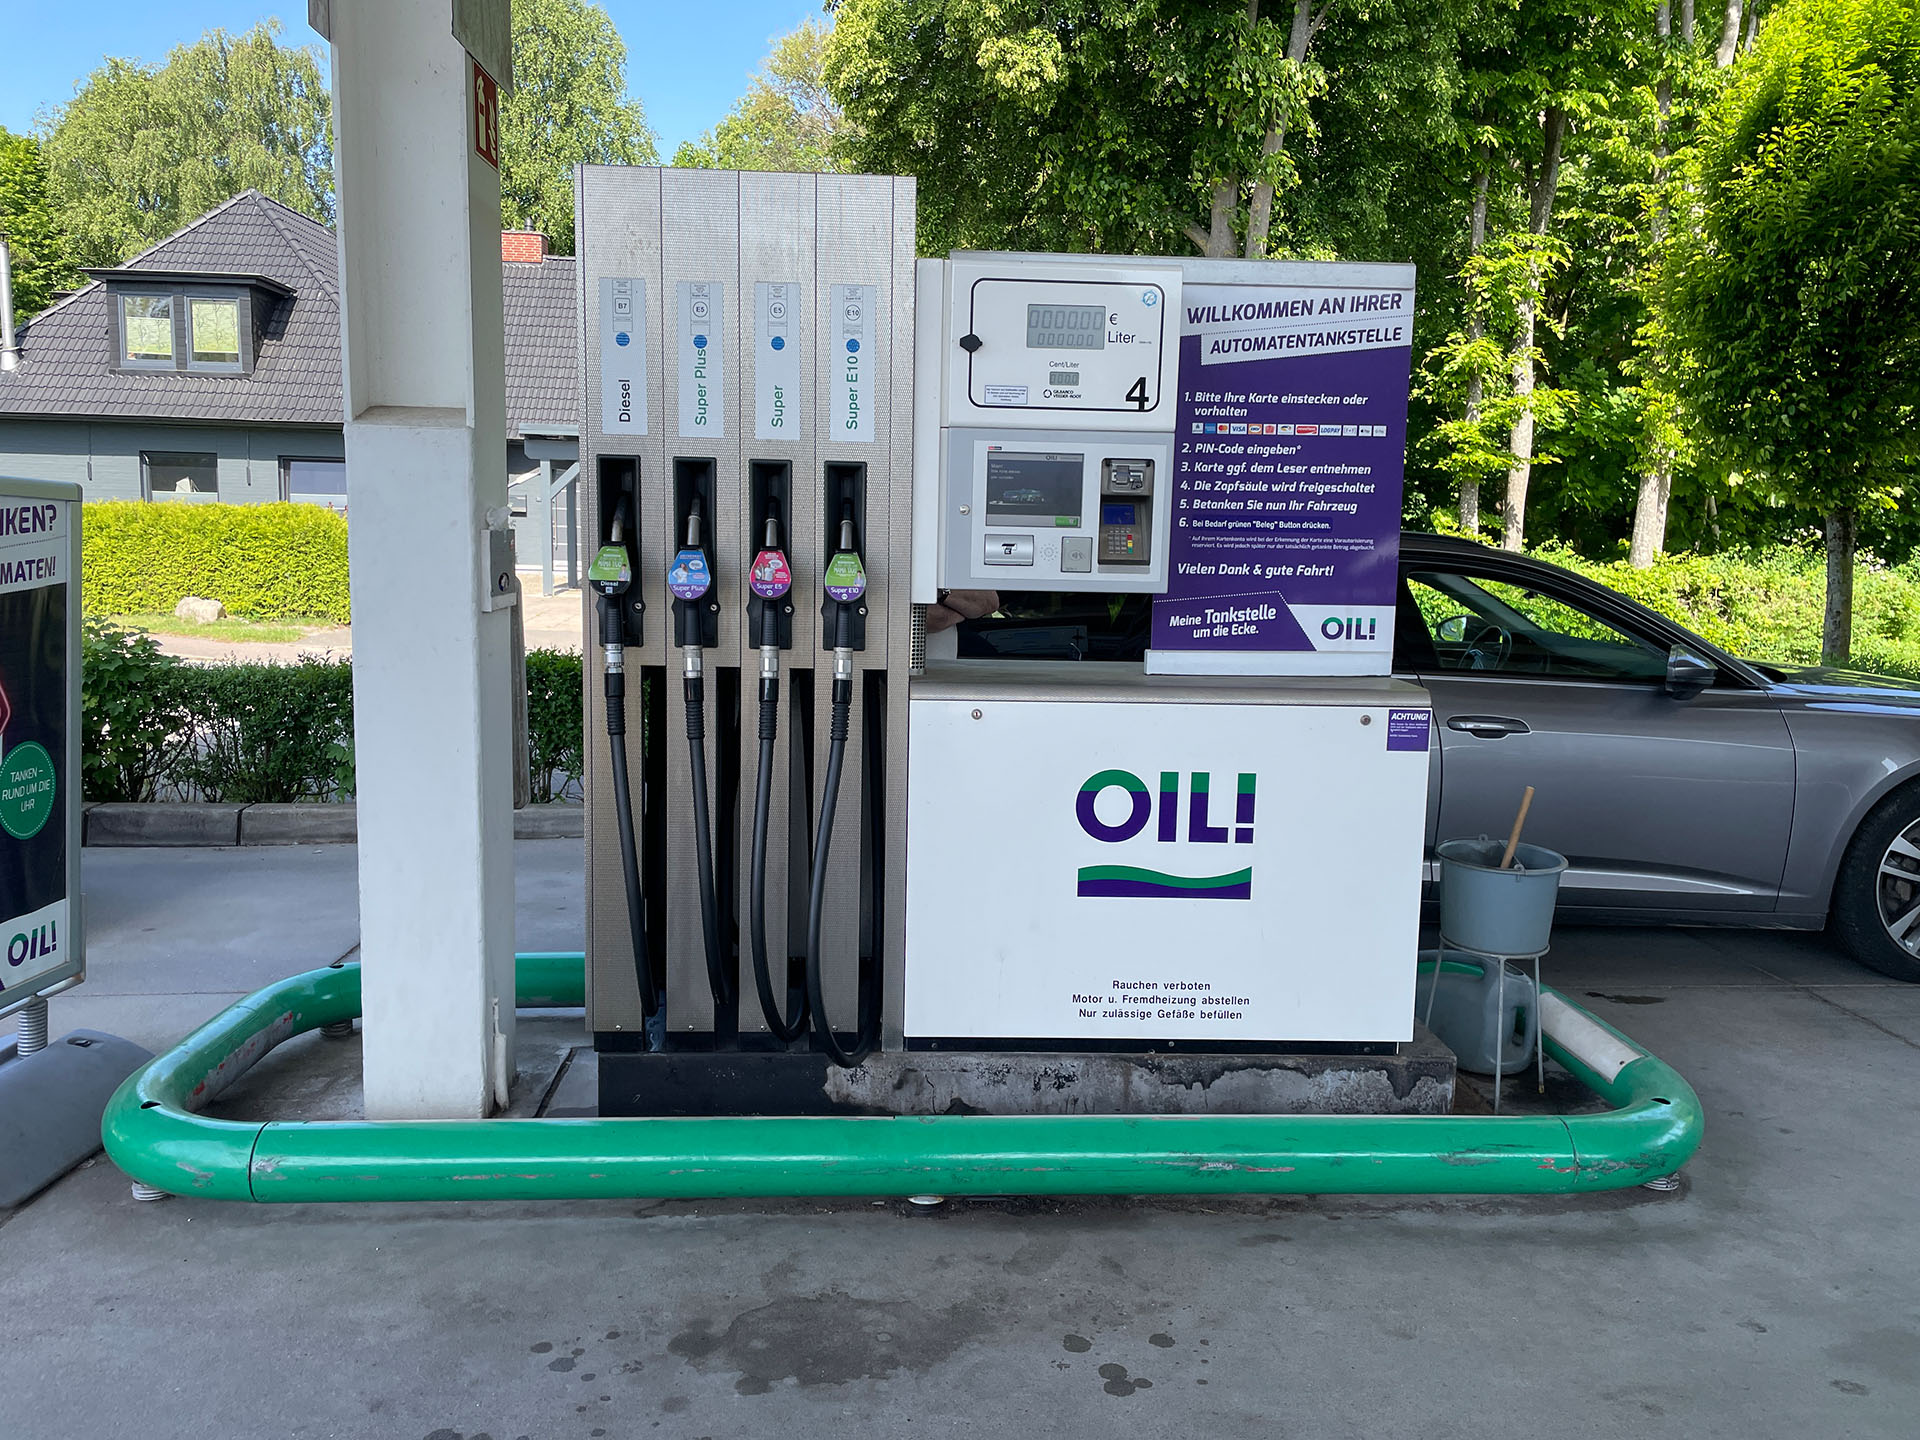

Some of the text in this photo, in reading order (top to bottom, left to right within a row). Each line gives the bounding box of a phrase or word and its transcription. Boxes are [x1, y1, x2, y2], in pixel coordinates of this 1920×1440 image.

[1187, 293, 1402, 324] WILLKOMMEN AN IHRER
[1109, 313, 1118, 326] €
[1108, 330, 1136, 344] Liter
[1210, 327, 1402, 354] AUTOMATENTANKSTELLE
[1048, 360, 1080, 368] Cent/Liter
[694, 348, 708, 426] Super Plus
[846, 356, 860, 430] Super E10
[1125, 376, 1150, 412] 4
[618, 380, 630, 422] Diesel
[771, 384, 786, 428] Super
[1184, 392, 1368, 405] 1. Bitte Ihre Karte einstecken oder
[1194, 405, 1248, 416] vorhalten
[1181, 443, 1192, 454] 2.
[1195, 443, 1244, 454] PIN-Code
[1181, 462, 1372, 476] 3. Karte ggf. dem Leser entnehmen
[1180, 480, 1376, 496] 4. Die Zapfsäule wird freigeschaltet
[1180, 499, 1358, 514] 5. Betanken Sie nun Ihr Fahrzeug
[1179, 517, 1190, 528] 6.
[1205, 520, 1228, 528] Bedarf
[1228, 520, 1252, 530] grünen
[1252, 520, 1278, 530] "Beleg"
[1302, 522, 1331, 530] drücken.
[0, 556, 56, 586] MATEN!
[1178, 562, 1334, 579] Vielen Dank & gute Fahrt!
[1170, 604, 1277, 627] Meine Tankstelle
[1193, 622, 1259, 639] um die Ecke.
[1320, 616, 1376, 641] OIL!
[1391, 712, 1429, 720] ACHTUNG!
[10, 768, 38, 782] TANKEN
[2, 779, 50, 800] RUND UM DIE
[20, 798, 35, 812] UHR
[1076, 769, 1256, 844] OIL!
[8, 920, 56, 967] OIL!
[1112, 980, 1211, 990] Rauchen verboten
[1072, 994, 1103, 1004] Motor
[1122, 994, 1197, 1006] Fremdheizung
[1202, 996, 1250, 1006] abstellen
[1078, 1008, 1242, 1020] Nur zulässige Gefäße befüllen
